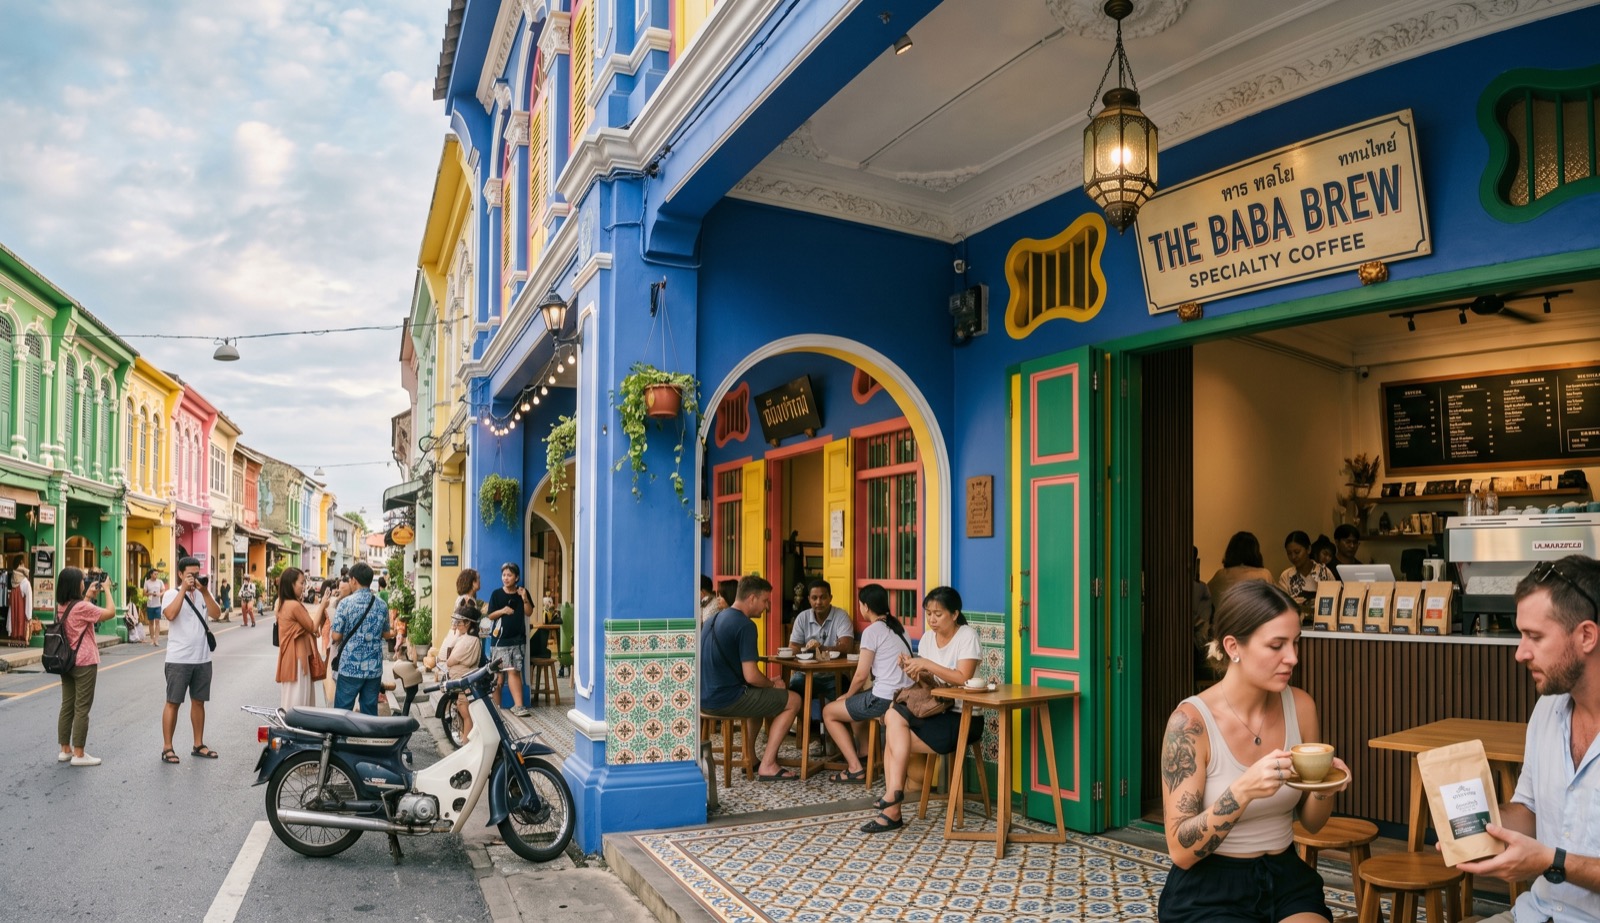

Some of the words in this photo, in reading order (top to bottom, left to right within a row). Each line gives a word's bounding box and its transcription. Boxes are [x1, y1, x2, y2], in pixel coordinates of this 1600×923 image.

[1148, 222, 1202, 273] THE
[1208, 196, 1294, 257] BABA
[1300, 164, 1402, 234] BREW
[1189, 251, 1282, 289] SPECIALTY
[1288, 232, 1366, 264] COFFEE
